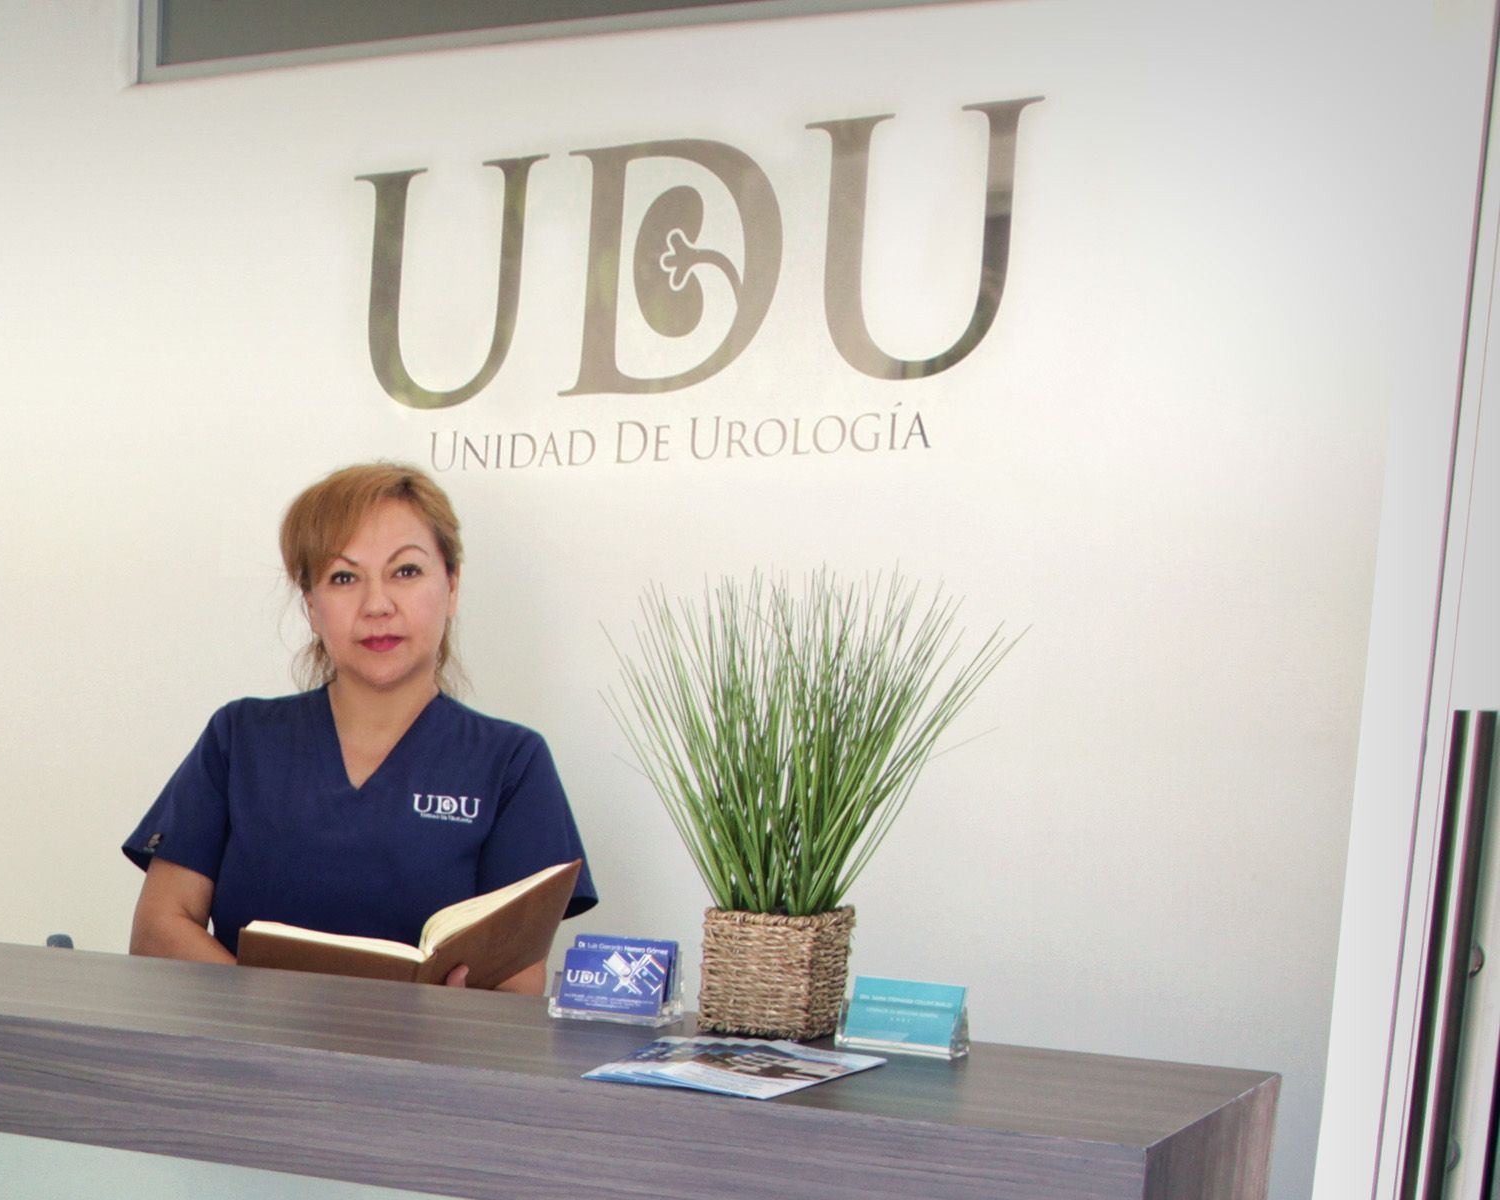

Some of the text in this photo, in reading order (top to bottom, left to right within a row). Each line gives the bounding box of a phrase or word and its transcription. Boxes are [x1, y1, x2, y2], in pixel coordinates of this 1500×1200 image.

[354, 96, 1046, 410] UDU
[413, 793, 481, 818] UDU
[566, 969, 608, 985] UDU
